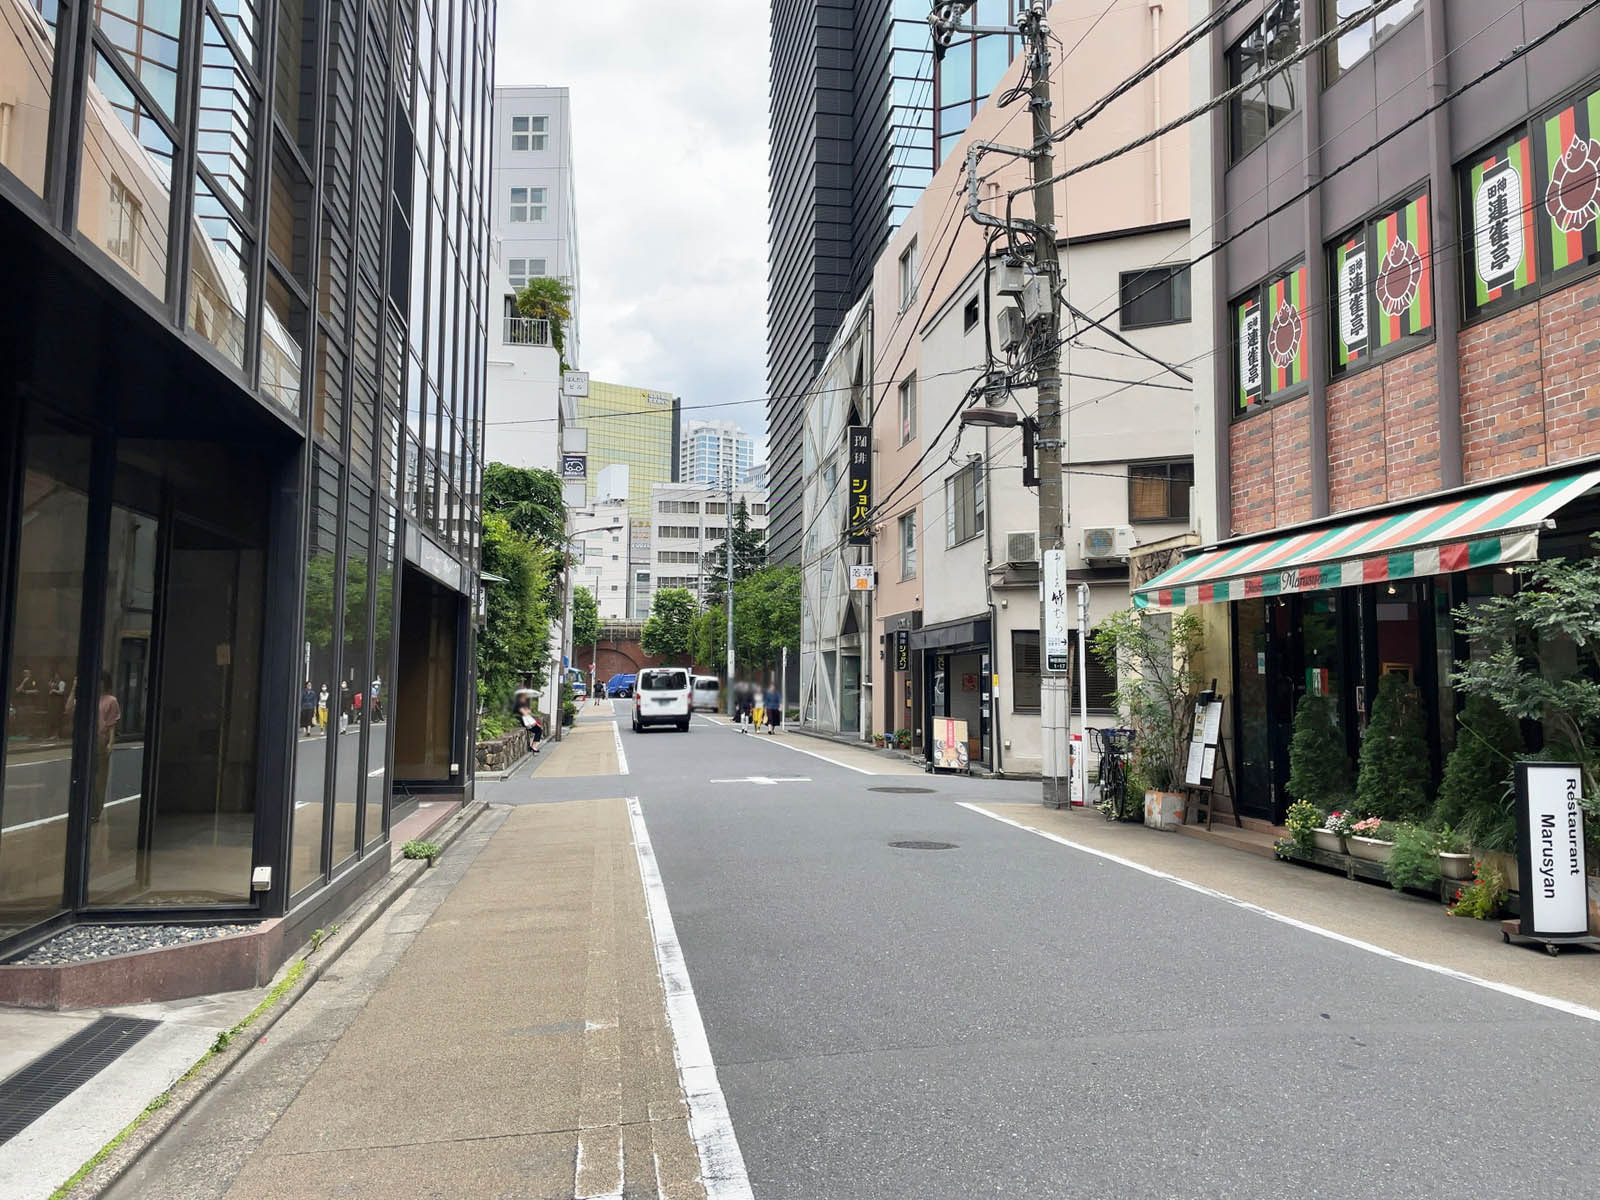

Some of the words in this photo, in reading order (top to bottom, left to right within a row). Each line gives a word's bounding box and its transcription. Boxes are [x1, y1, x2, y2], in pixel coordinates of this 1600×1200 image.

[1488, 193, 1511, 271] 連雀亭
[1348, 271, 1365, 337] 連雀亭
[1539, 814, 1555, 899] Marusyan
[1566, 778, 1579, 876] Restaurant
